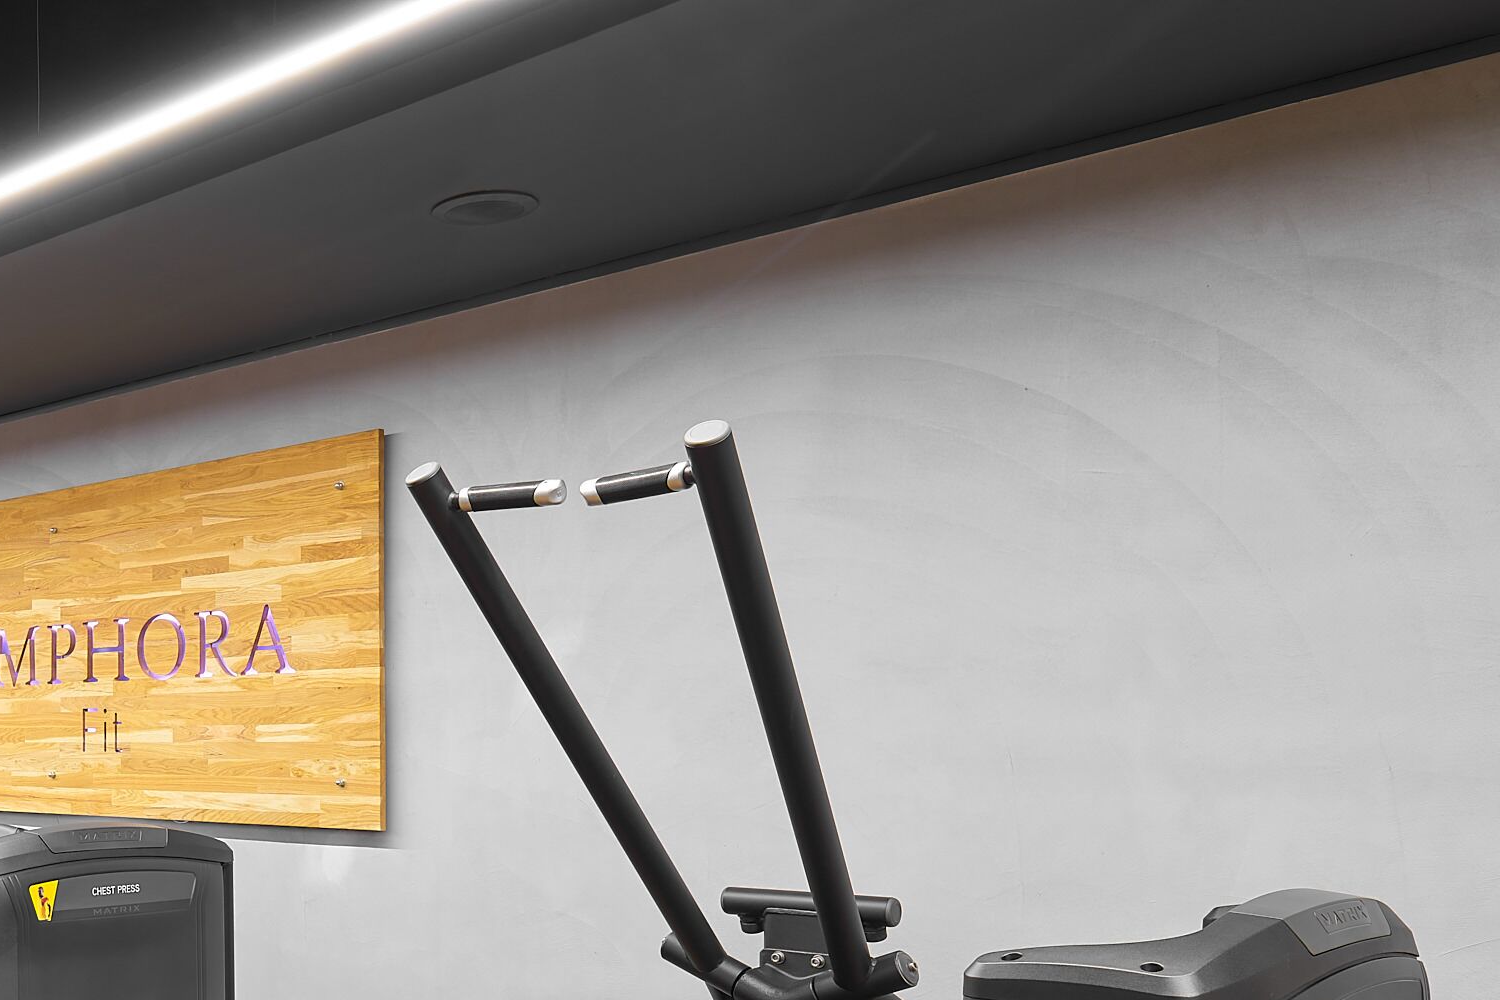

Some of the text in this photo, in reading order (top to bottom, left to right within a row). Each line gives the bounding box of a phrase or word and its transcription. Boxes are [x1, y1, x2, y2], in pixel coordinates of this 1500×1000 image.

[82, 707, 122, 753] Fit
[92, 884, 140, 896] CHEST PRESS
[93, 905, 140, 916] MATRIX
